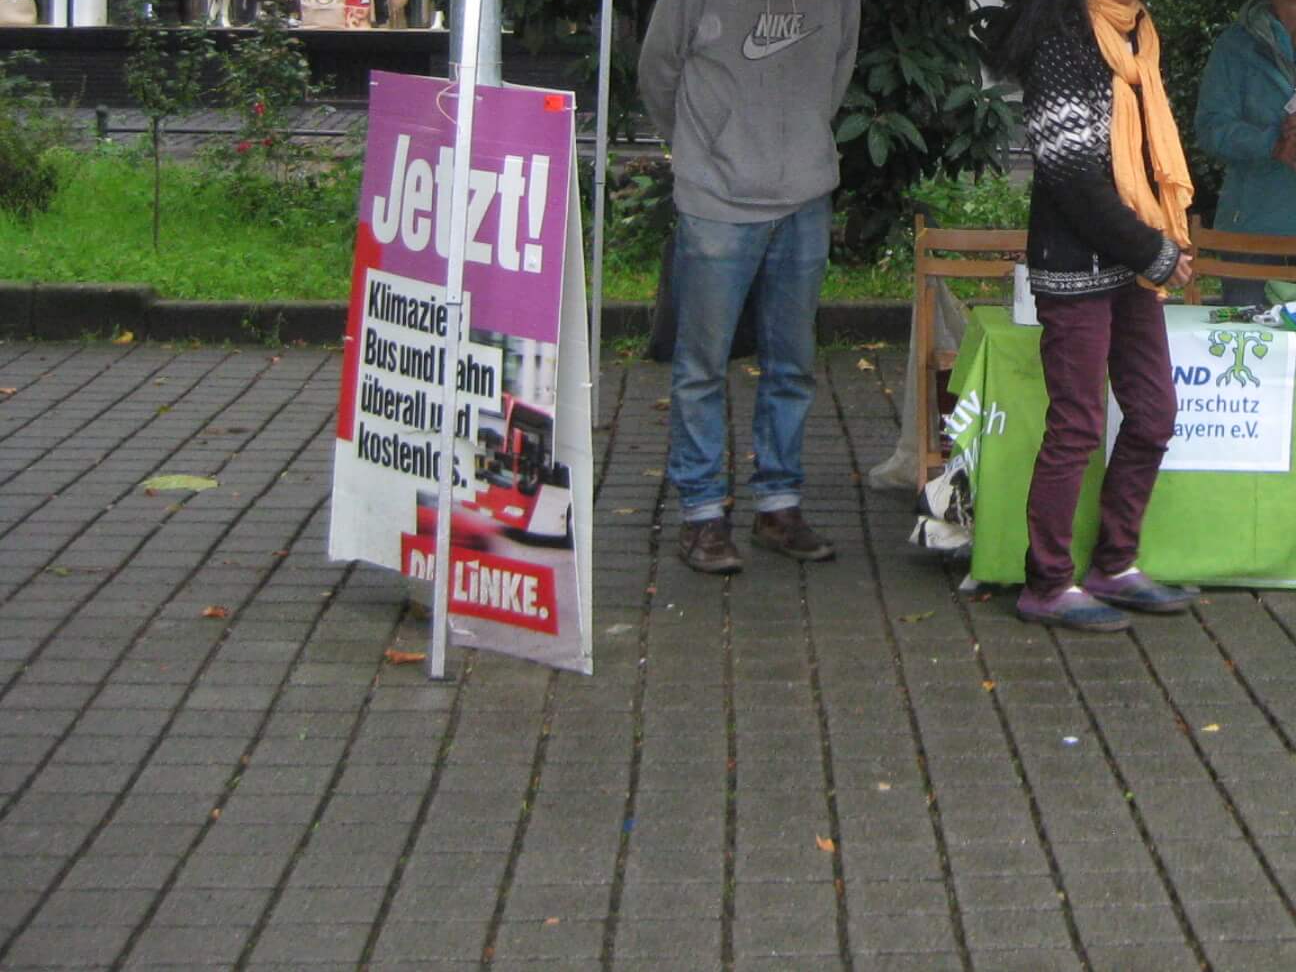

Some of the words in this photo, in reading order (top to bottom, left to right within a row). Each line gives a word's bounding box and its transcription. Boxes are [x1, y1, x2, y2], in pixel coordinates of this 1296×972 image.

[372, 134, 550, 273] Jetzt!
[368, 280, 463, 341] Klimazie
[364, 327, 398, 373] Bus
[400, 344, 436, 384] und
[1173, 365, 1212, 386] ND
[361, 374, 426, 430] überall
[430, 402, 471, 438] ud
[1174, 422, 1225, 442] ayern
[1230, 420, 1259, 439] e.V.
[1178, 394, 1260, 414] urschutz
